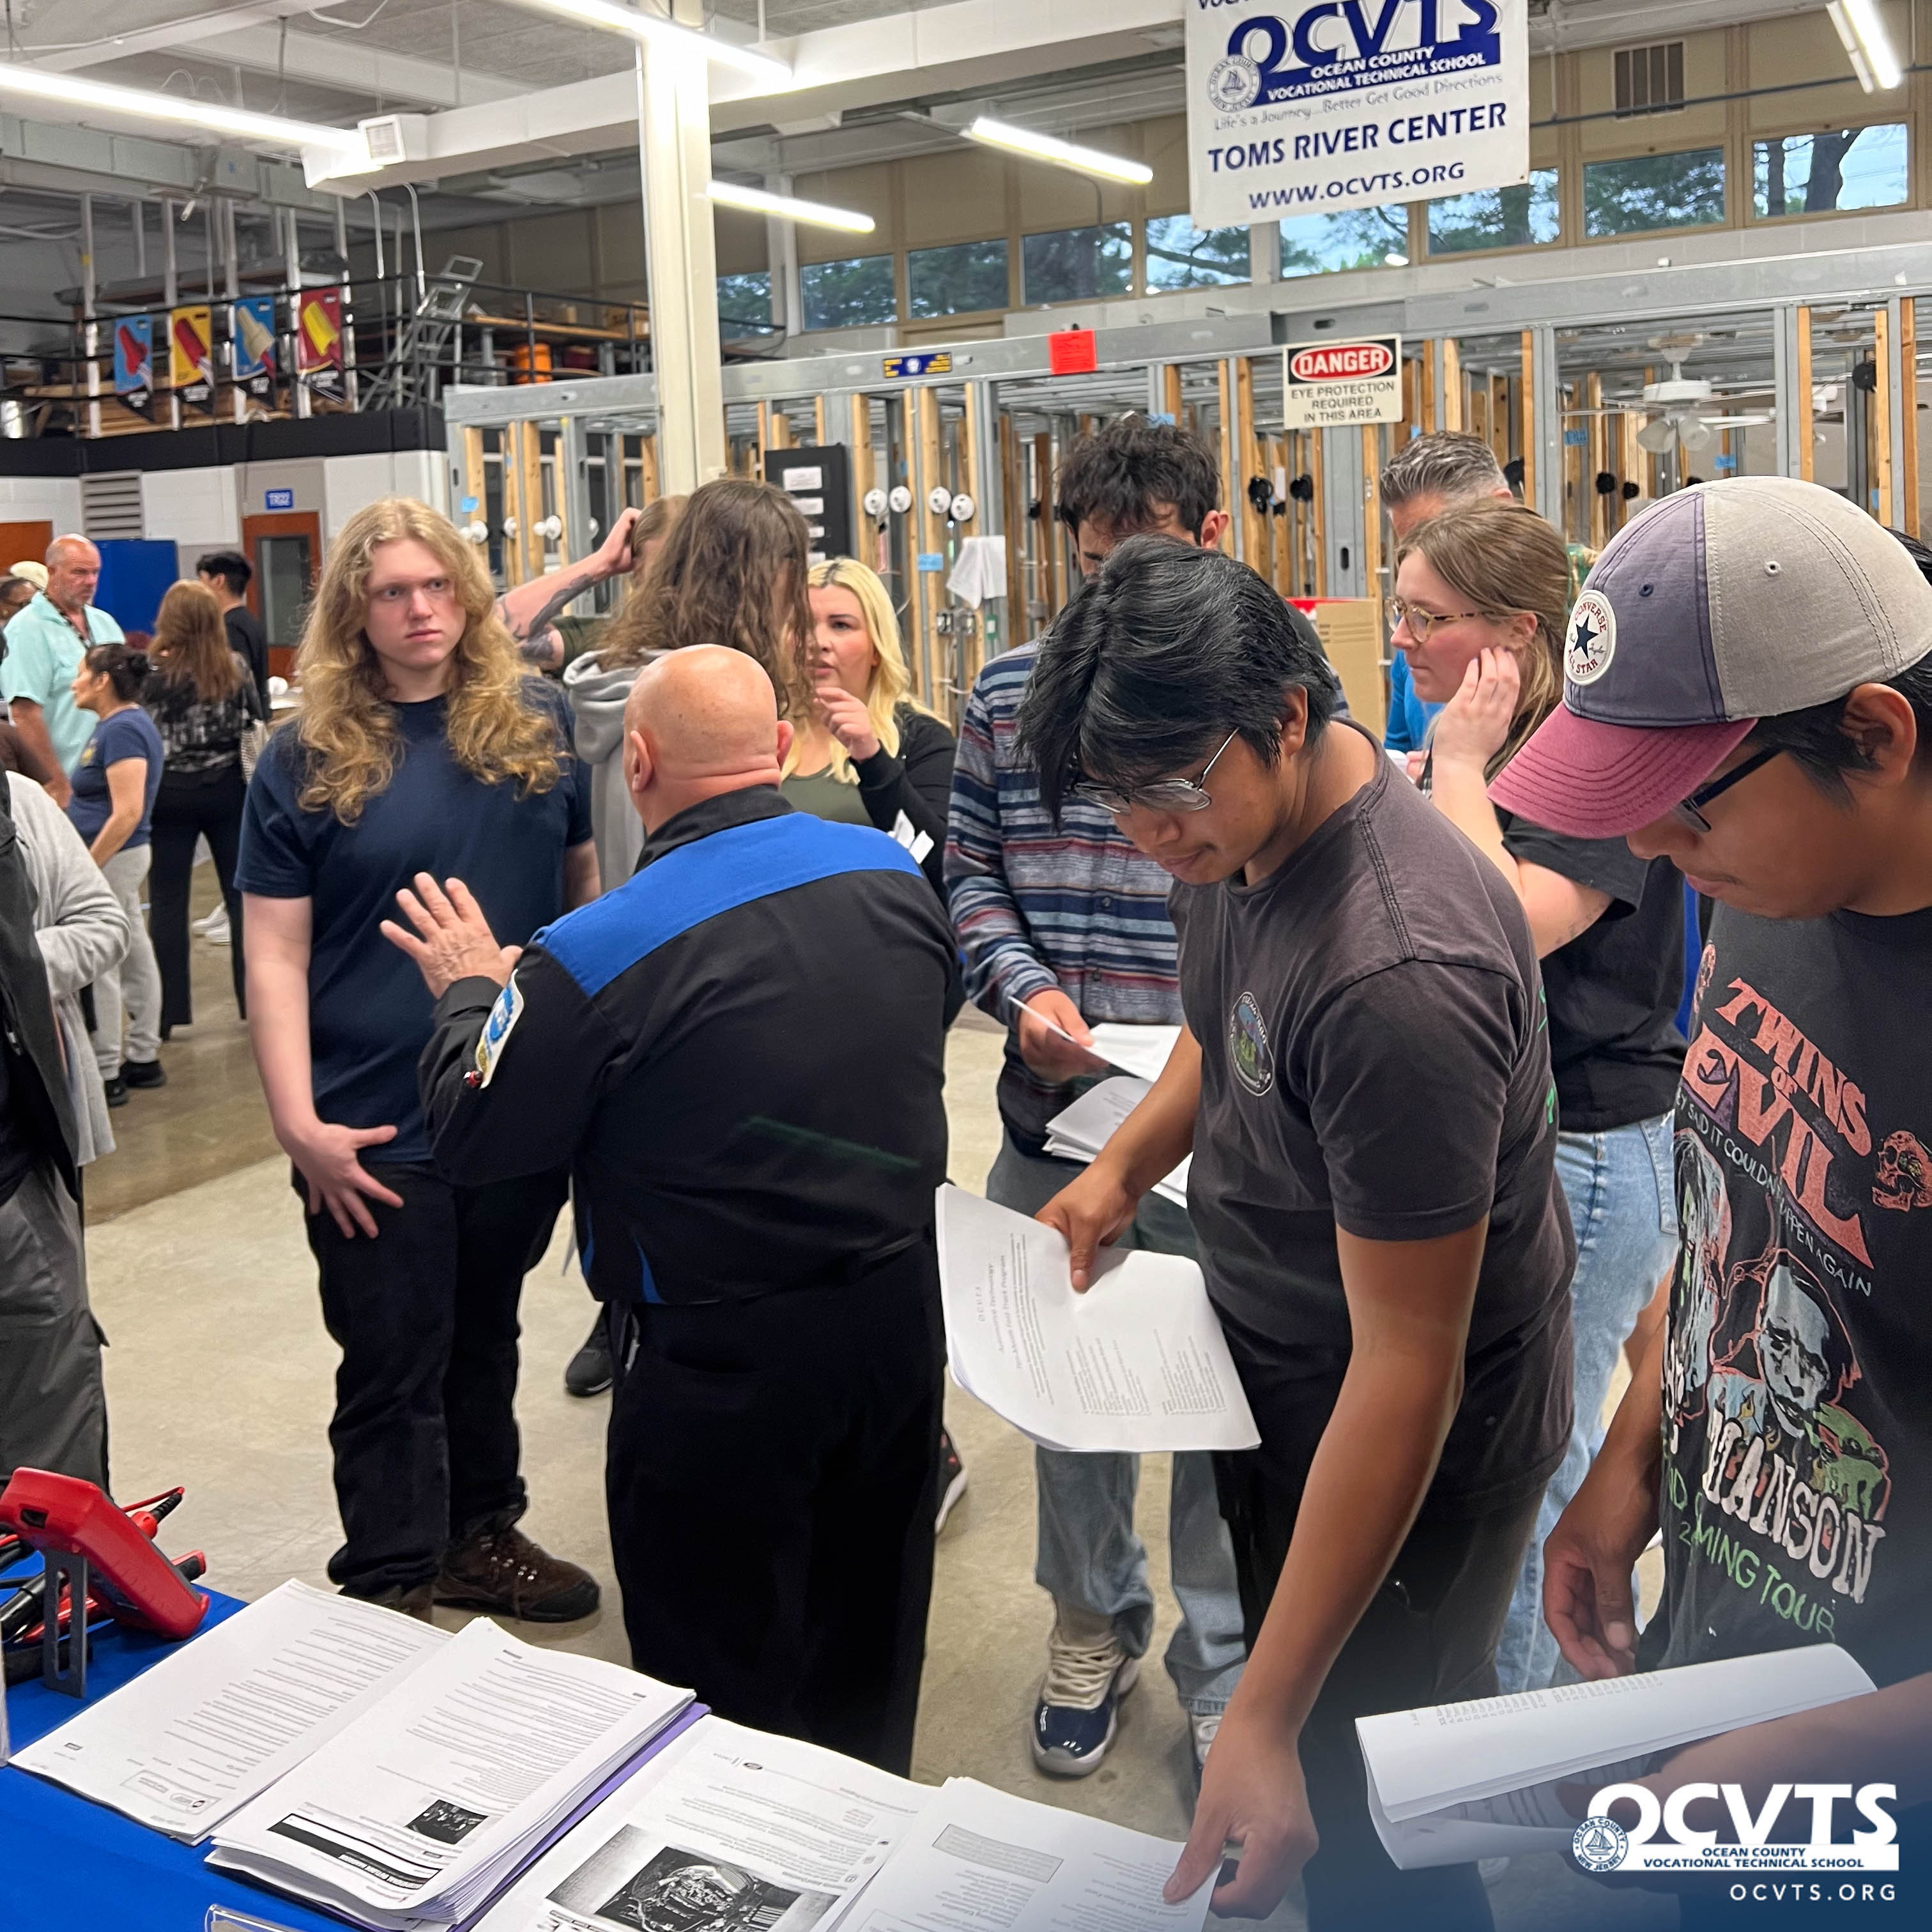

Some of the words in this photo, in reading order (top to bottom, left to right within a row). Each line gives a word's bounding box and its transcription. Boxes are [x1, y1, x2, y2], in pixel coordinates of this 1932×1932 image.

[1227, 0, 1503, 72] OCVTS
[1267, 75, 1353, 101] VOCATIONAL
[1353, 63, 1429, 86] TECHNICAL
[1430, 52, 1486, 72] SCHOOL
[1310, 58, 1366, 79] OCEAN
[1368, 45, 1435, 68] COUNTY
[1393, 82, 1429, 100] Good
[1433, 73, 1503, 94] Directions
[1208, 139, 1284, 173] TOMS
[1294, 123, 1378, 160] RIVER
[1389, 102, 1506, 144] CENTER
[1250, 162, 1464, 210] WWW.OCVTS.ORG
[1299, 349, 1384, 375] DANGER
[1291, 388, 1314, 399] EYE
[1317, 381, 1394, 397] PROTECTION
[1312, 397, 1374, 410] REQUIRED
[1304, 413, 1315, 422] IN
[1320, 410, 1344, 422] THIS
[1349, 408, 1381, 418] AREA
[1574, 602, 1607, 632] CONVERSE
[1576, 659, 1598, 673] STAR
[1715, 977, 1873, 1156] TWINS
[1682, 1022, 1874, 1269] EVIL
[1710, 1125, 1724, 1147] IT
[1816, 1247, 1872, 1298] AGAIN
[1759, 1565, 1836, 1643] TOUR
